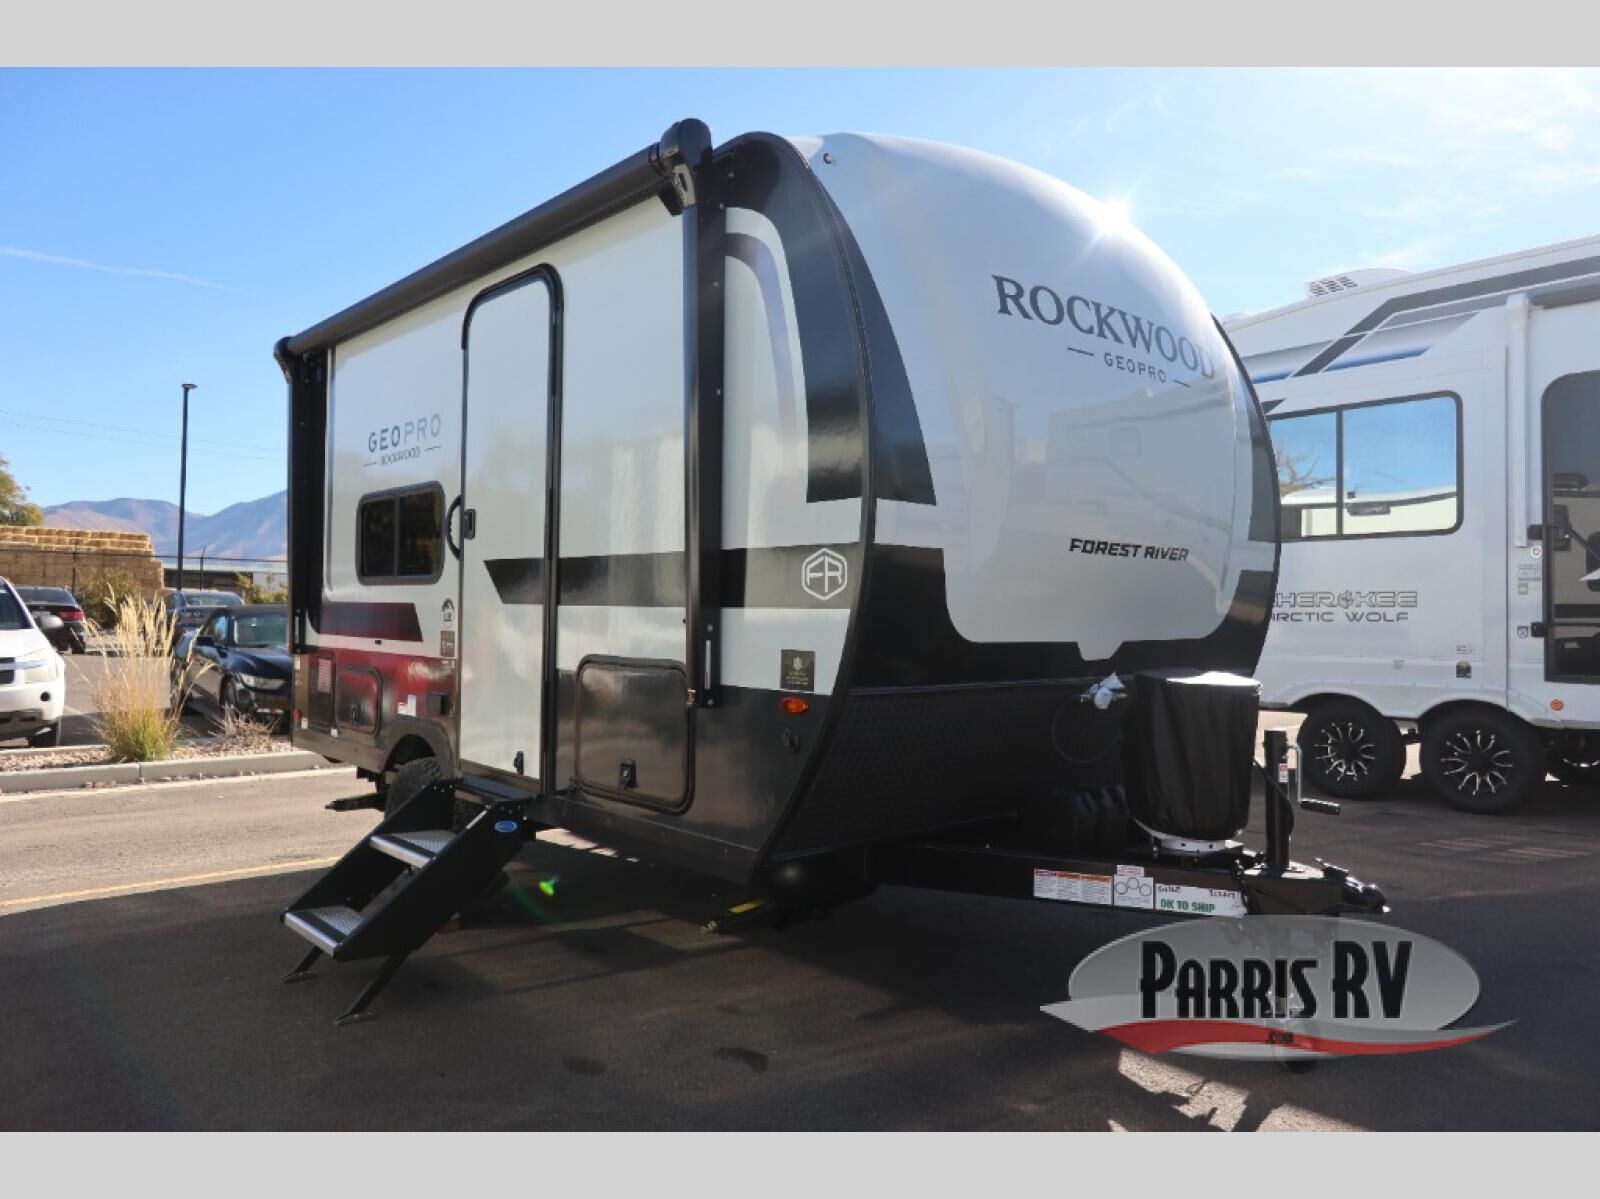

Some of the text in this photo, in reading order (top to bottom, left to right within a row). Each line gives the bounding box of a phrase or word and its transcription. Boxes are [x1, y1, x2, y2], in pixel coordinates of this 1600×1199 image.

[991, 274, 1215, 379] ROCKWOOD
[1103, 352, 1167, 383] GEOPRO
[368, 413, 441, 453] GEOPRO
[1069, 538, 1189, 561] FOREST RIVER
[1274, 590, 1417, 608] HEROKEE
[1345, 611, 1408, 622] WOLF
[1160, 898, 1174, 909] OK
[1176, 900, 1189, 911] TO
[1191, 901, 1216, 913] SHIP
